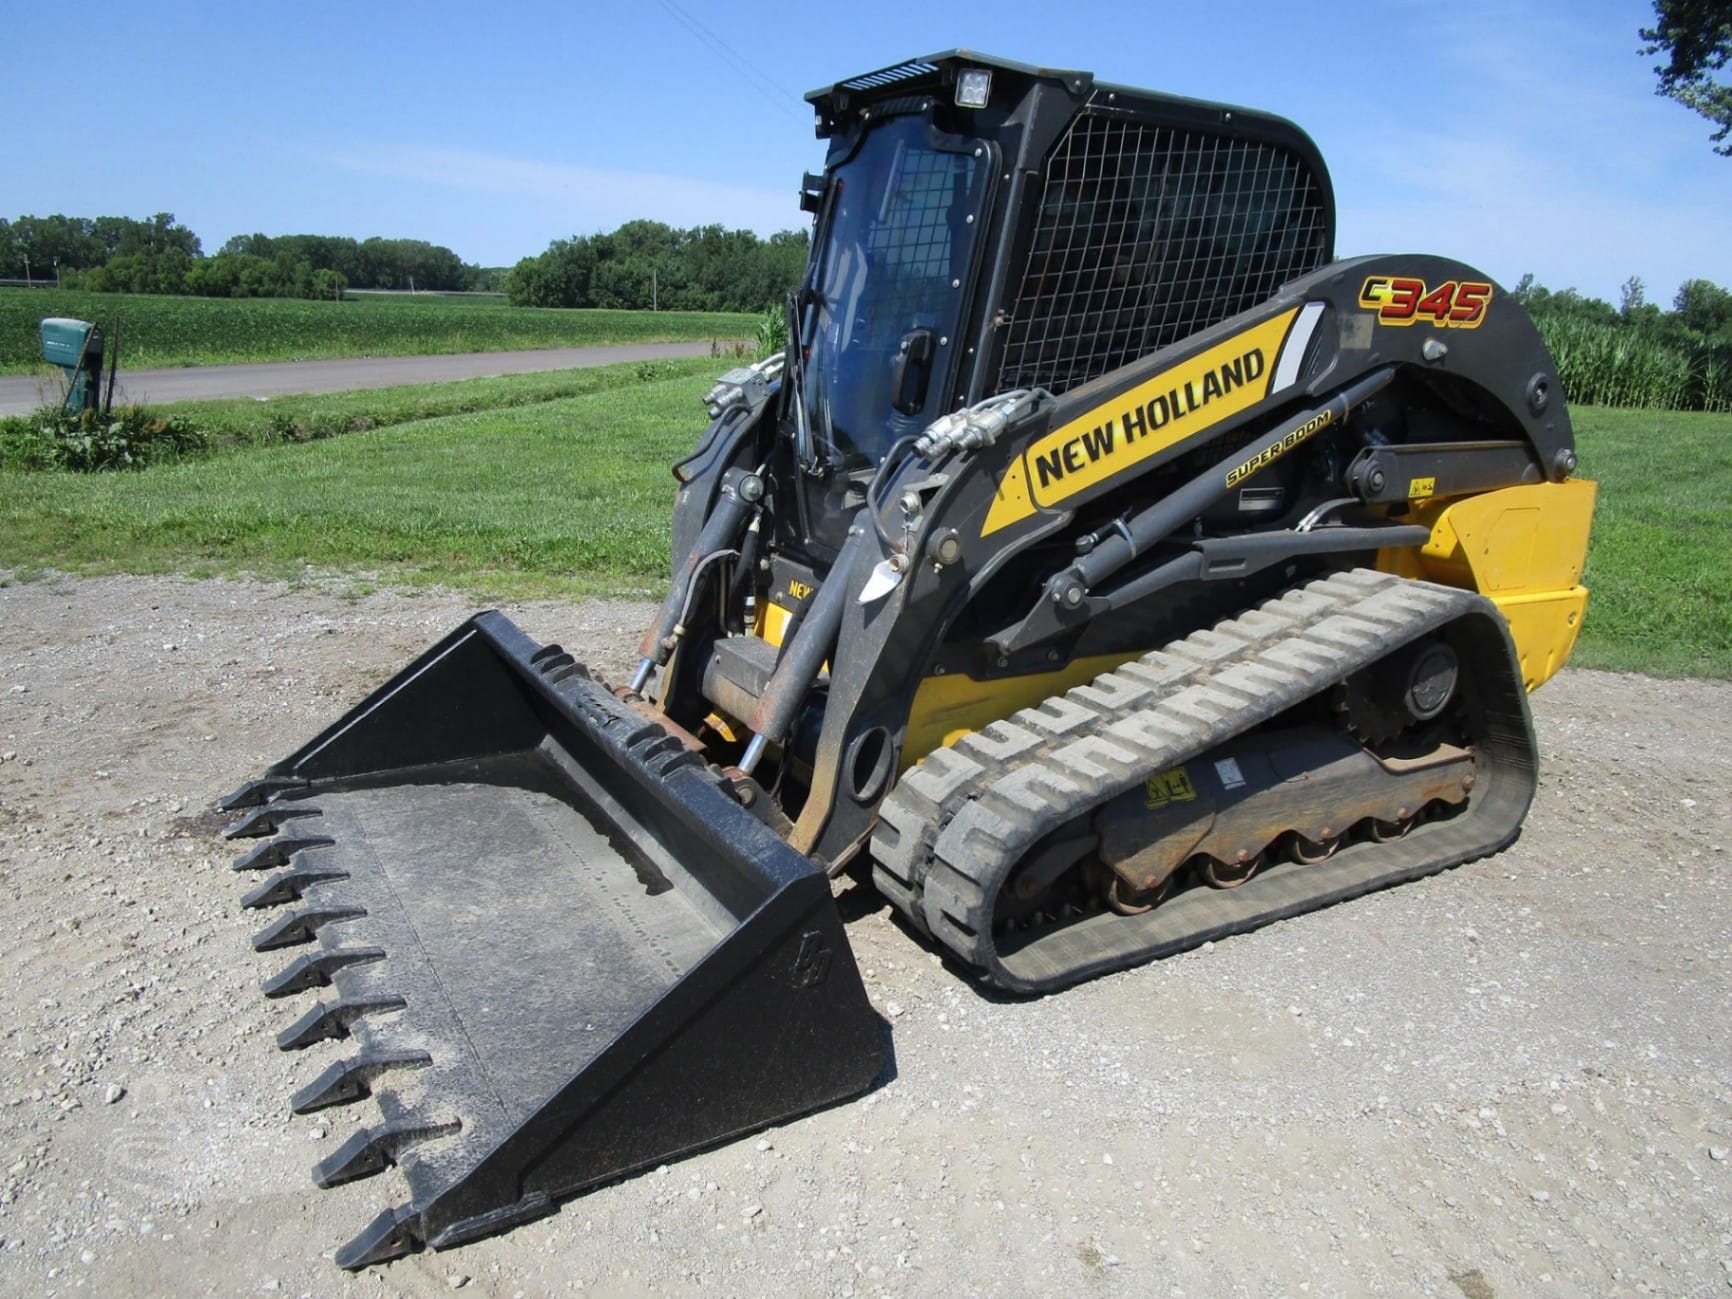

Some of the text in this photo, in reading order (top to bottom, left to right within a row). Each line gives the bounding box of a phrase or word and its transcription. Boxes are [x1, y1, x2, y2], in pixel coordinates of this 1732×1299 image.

[1359, 276, 1493, 328] C345
[1035, 347, 1265, 489] NEW HOLLAND
[1226, 410, 1331, 487] SUPER BOOM
